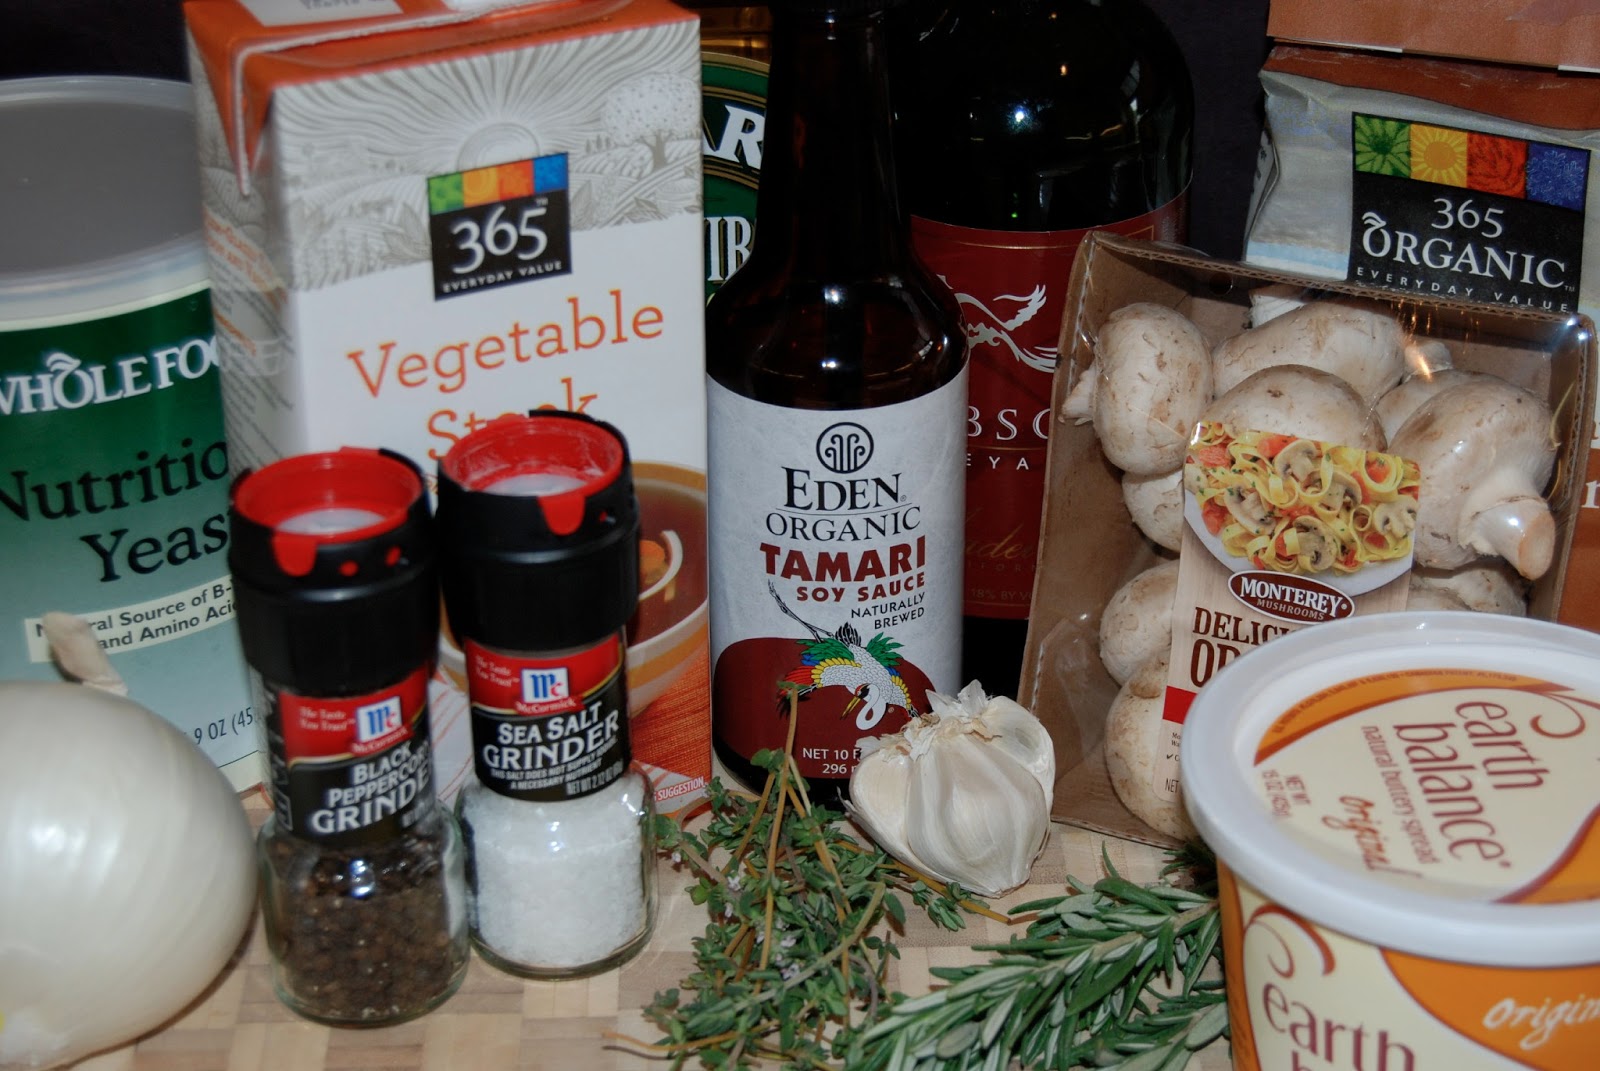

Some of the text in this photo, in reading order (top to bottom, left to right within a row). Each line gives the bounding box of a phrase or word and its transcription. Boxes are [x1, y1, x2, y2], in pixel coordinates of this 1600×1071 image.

[1431, 198, 1504, 238] 365
[452, 206, 549, 274] 365
[1361, 212, 1565, 288] ORGANIC
[442, 260, 563, 293] EVERYDAY VALUE
[1357, 266, 1569, 313] EVERYDAY VALUE
[347, 289, 665, 399] Vegetable
[781, 466, 902, 511] EDEN
[766, 506, 921, 542] ORGANIC
[80, 510, 230, 582] Yeas
[759, 535, 926, 582] TAMARI
[796, 571, 925, 602] SOY SAUCE
[851, 591, 925, 618] NATURALLY
[1240, 577, 1343, 618] MONTEREY
[120, 601, 186, 627] Source
[191, 589, 208, 607] of
[874, 607, 925, 630] BREWED
[1193, 607, 1293, 646] DELIC
[1256, 599, 1325, 621] MUSHROOMS
[99, 631, 133, 649] and
[140, 616, 200, 642] Amino
[208, 718, 227, 740] OZ
[482, 709, 619, 770] GRINDER
[497, 701, 602, 745] SEA SALT
[353, 740, 412, 786] BLACK
[803, 747, 830, 760] NET
[834, 749, 849, 760] 10
[1361, 726, 1399, 768] natural
[1454, 701, 1550, 790] earth
[822, 763, 847, 774] 296
[1393, 722, 1506, 861] balance
